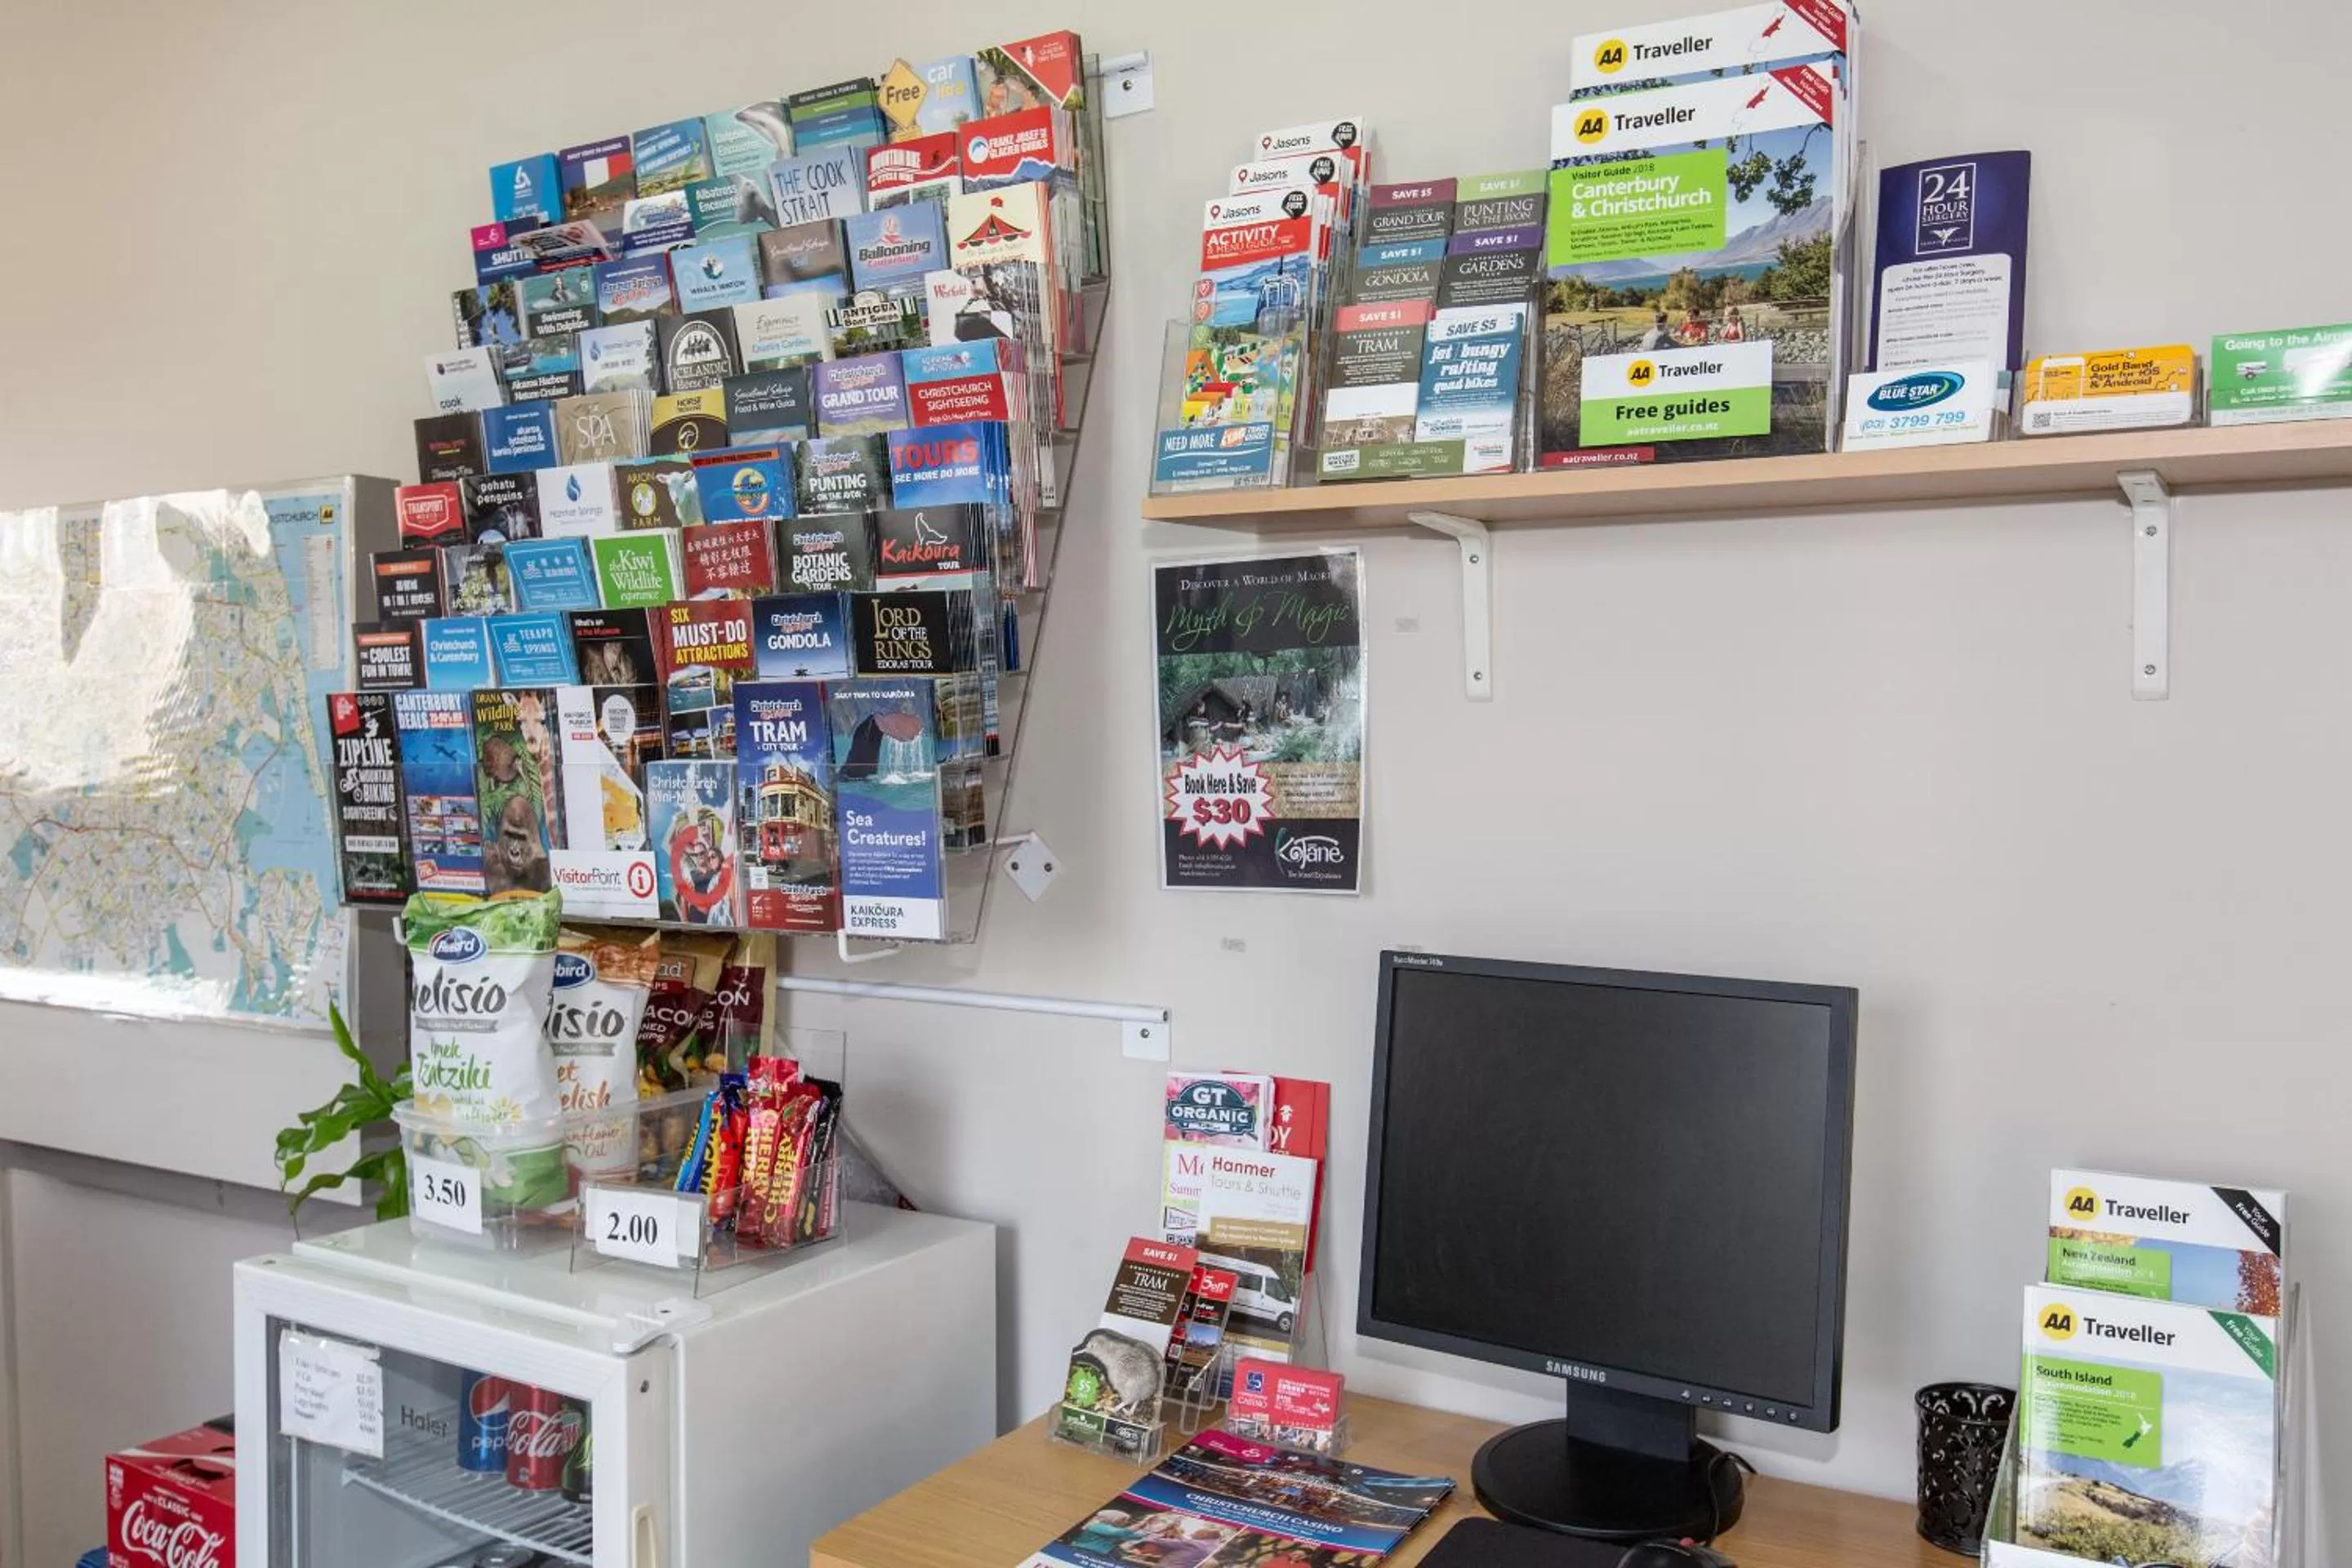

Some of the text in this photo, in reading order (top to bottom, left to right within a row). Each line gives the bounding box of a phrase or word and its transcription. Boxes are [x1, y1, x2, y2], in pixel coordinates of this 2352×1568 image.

[1598, 36, 1713, 66] AA Traveller
[928, 62, 956, 82] car
[887, 84, 920, 106] Free
[1578, 105, 1696, 136] AA Traveller
[1273, 136, 1311, 150] Jasons
[776, 168, 804, 194] THE
[807, 161, 845, 190] COOK
[1250, 169, 1288, 183] Jasons
[1571, 166, 1632, 181] Visitor Guide
[1392, 188, 1432, 199] SAVE $5
[1480, 181, 1506, 192] SAVE
[1571, 175, 1680, 201] Canterbury
[1922, 170, 1970, 203] 24
[782, 193, 832, 223] STRAIT
[1223, 203, 1262, 219] Jasons
[1463, 198, 1534, 218] PUNTING
[1571, 187, 1712, 219] & Christchurch
[1922, 202, 1969, 216] HOUR
[1374, 212, 1446, 229] GRAND TOUR
[1922, 211, 1969, 223] SURGERY
[1208, 225, 1280, 246] ACTIVITY
[1475, 237, 1503, 247] SAVE
[859, 240, 930, 261] Ballooning
[1381, 249, 1408, 260] SAVE
[1459, 258, 1526, 275] GARDENS
[1365, 272, 1429, 287] GONDOLA
[843, 303, 897, 318] ANTIGUA
[1359, 312, 1387, 322] SAVE
[537, 323, 555, 334] With
[1446, 319, 1498, 336] SAVE $5
[1356, 339, 1398, 354] TRAM
[2225, 334, 2310, 350] Going to the
[1431, 341, 1511, 364] jet bungy
[674, 360, 728, 377] ICELANDIC
[1440, 361, 1498, 377] rafting
[1630, 361, 1723, 380] AA Traveller
[2091, 359, 2154, 372] Gold Band
[2138, 367, 2160, 376] iOS
[919, 381, 991, 399] CHRISTCHURCH
[1433, 376, 1498, 394] quad bikes
[2090, 376, 2153, 389] & Android
[822, 385, 898, 408] GRAND TOUR
[1878, 384, 1939, 400] BLUE STAR
[928, 394, 988, 411] SIGHTSEEING
[1616, 397, 1731, 421] Free guides
[1890, 414, 1929, 429] 3799
[1936, 411, 1966, 425] 799
[577, 417, 615, 448] SPA
[1165, 436, 1187, 452] NEED
[1190, 433, 1214, 448] MORE
[894, 439, 978, 470] TOURS
[1563, 451, 1638, 464] aatraveller.co.nz
[809, 474, 866, 491] PUNTING
[895, 466, 979, 483] SEE MORE DO MORE
[480, 479, 515, 492] pohatu
[408, 500, 443, 514] TRANSPORT
[477, 491, 523, 506] penguins
[633, 515, 662, 528] FARM
[881, 538, 960, 564] Kaikoura
[619, 550, 654, 570] Kiwi
[793, 552, 848, 570] BOTANIC
[938, 561, 960, 570] TOUR
[611, 571, 663, 590] Wildlife
[791, 568, 852, 583] GARDENS
[1180, 580, 1229, 590] DISCOVER
[1241, 574, 1278, 587] WORLD
[670, 607, 688, 624] SIX
[871, 598, 921, 639] LORD
[1165, 592, 1234, 652] Myth
[519, 628, 554, 639] TEKAPO
[673, 619, 746, 647] MUST-DO
[768, 633, 831, 650] GONDOLA
[892, 626, 928, 640] OF THE
[370, 646, 410, 662] COOLEST
[522, 642, 557, 654] SPRINGS
[676, 642, 748, 665] ATTRACTIONS
[875, 640, 932, 660] RINGS
[362, 665, 387, 678] FUN IN
[910, 660, 933, 669] TOUR
[394, 694, 461, 711] CANTERBURY
[399, 712, 429, 729] DEALS
[477, 704, 521, 723] Wildlife
[494, 720, 515, 732] PARK
[750, 721, 807, 742] TRAM
[338, 738, 394, 768] ZIPLINE
[762, 743, 800, 752] CITY TOUR
[1185, 774, 1257, 794] Book Here & Save
[364, 783, 395, 803] BIKING
[846, 810, 873, 827] Sea
[1193, 797, 1251, 826] $30
[849, 829, 926, 847] Creatures!
[554, 867, 621, 885] VisitorPoint
[851, 915, 897, 929] EXPRESS
[1193, 1087, 1227, 1105] GT
[1172, 1107, 1249, 1124] ORGANIC
[752, 1109, 780, 1199] CHERRY
[1213, 1156, 1276, 1178] Hanmer
[424, 1174, 466, 1207] 3.50
[1211, 1175, 1301, 1200] Tours & Shuttle
[2069, 1196, 2190, 1225] AA Traveller
[2234, 1202, 2253, 1220] Free
[607, 1212, 657, 1245] 2.00
[1143, 1247, 1165, 1259] SAVE
[2090, 1250, 2136, 1267] Zealand
[1133, 1273, 1169, 1290] TRAM
[2043, 1313, 2176, 1346] AA Traveller
[2225, 1319, 2245, 1338] Free
[1546, 1361, 1606, 1383] SAMSUNG
[2035, 1365, 2113, 1386] South Island
[401, 1405, 448, 1438] Haier
[471, 1435, 506, 1450] pep
[1186, 1493, 1343, 1533] CHRISTCHURCH CASINO
